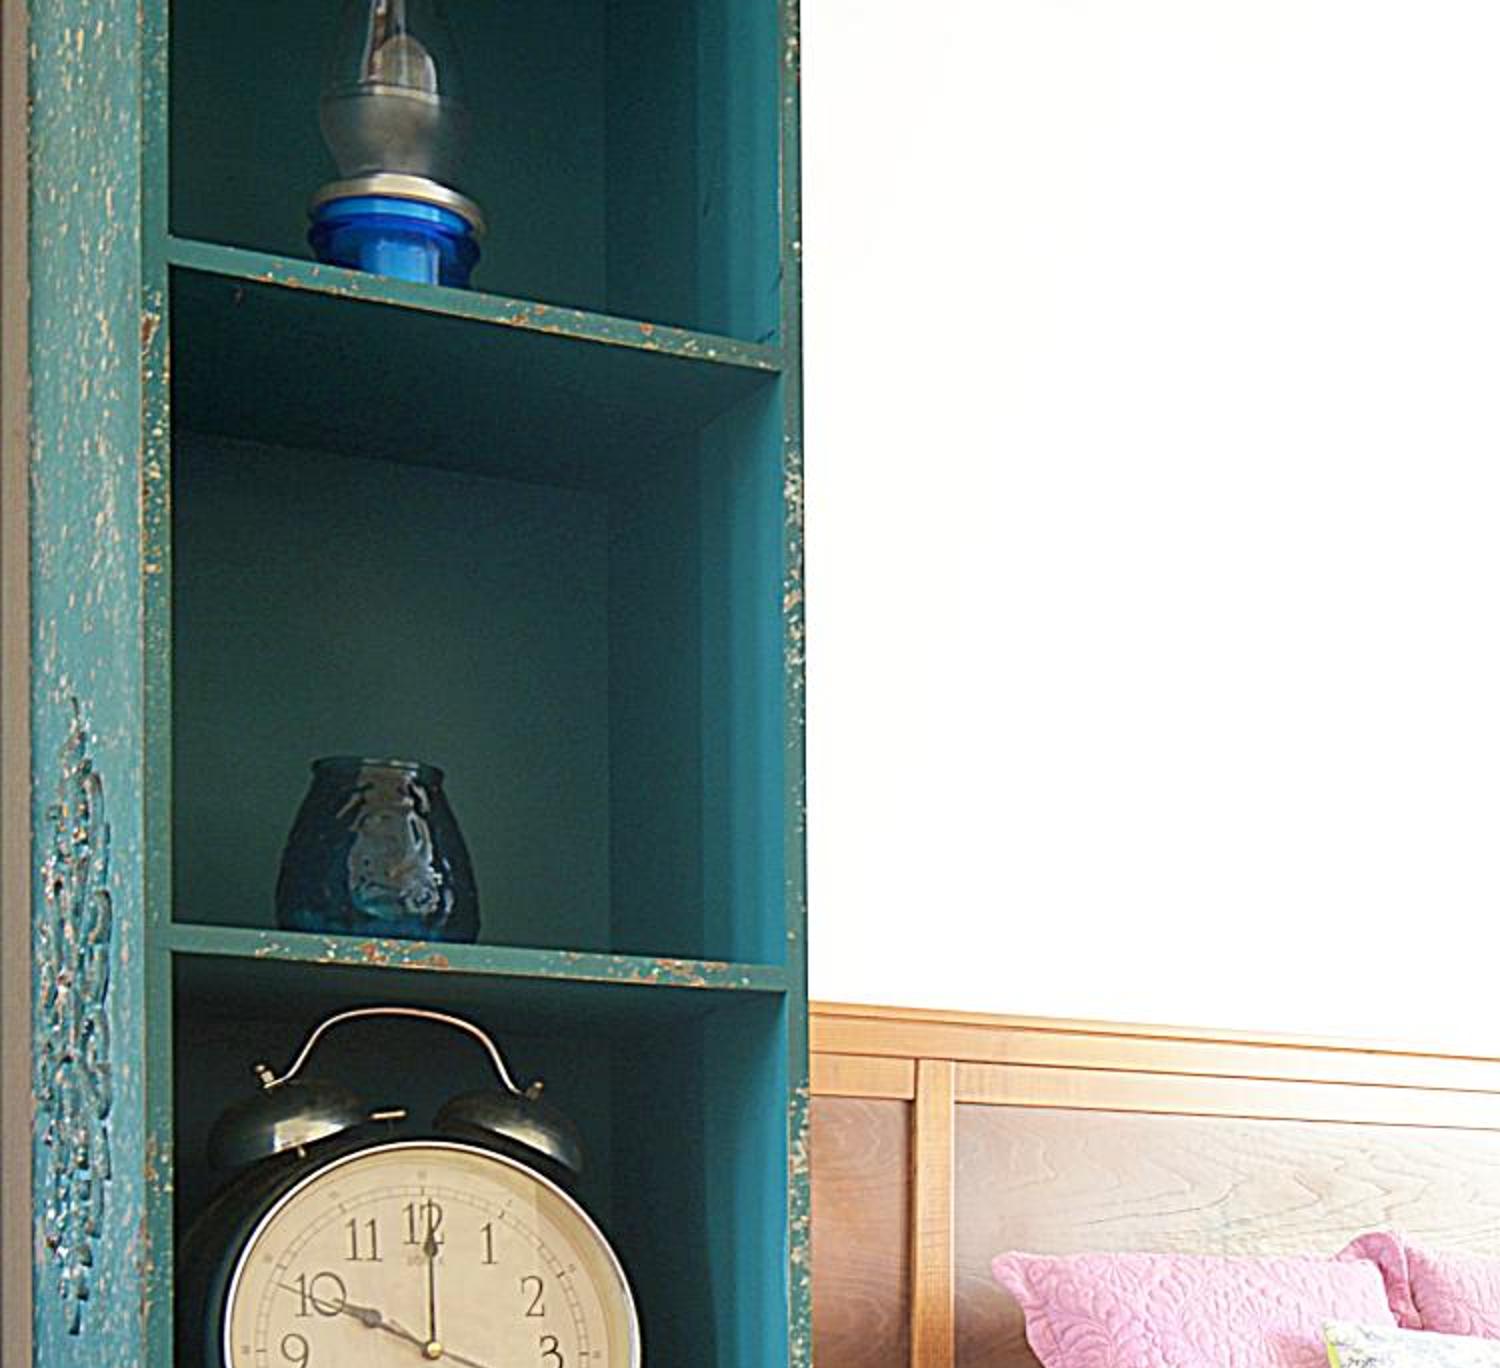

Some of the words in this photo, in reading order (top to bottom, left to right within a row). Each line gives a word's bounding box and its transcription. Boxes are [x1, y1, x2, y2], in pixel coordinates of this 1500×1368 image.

[344, 1217, 383, 1261] 11
[402, 1200, 444, 1245] 12
[480, 1222, 498, 1264] 1
[294, 1271, 347, 1317] 10
[520, 1276, 545, 1317] 2
